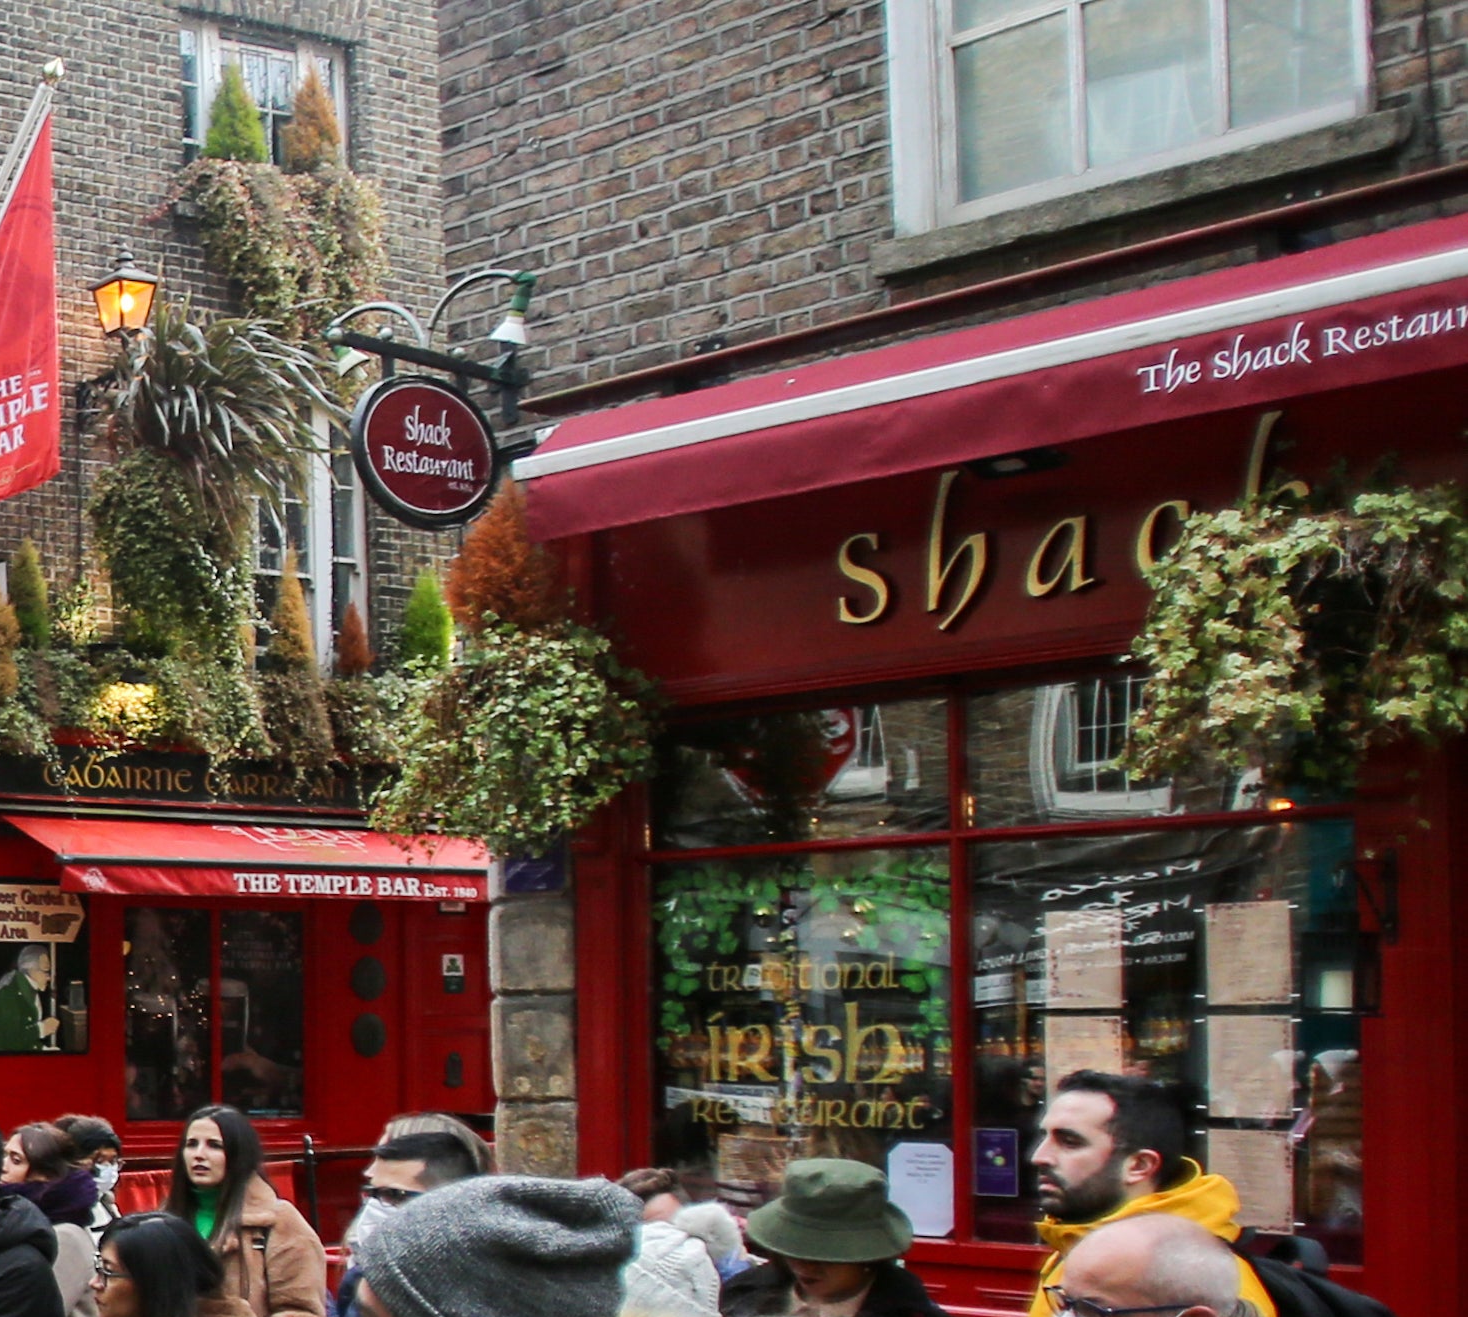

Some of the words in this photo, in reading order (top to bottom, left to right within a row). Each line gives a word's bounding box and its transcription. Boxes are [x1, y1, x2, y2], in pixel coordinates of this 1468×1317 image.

[1137, 349, 1202, 393] The
[1213, 321, 1312, 380] Shack
[382, 445, 476, 481] Restaurant
[233, 873, 281, 893] THE
[284, 874, 373, 896] TEMPLE
[377, 877, 422, 898] BAR
[0, 924, 29, 940] Area
